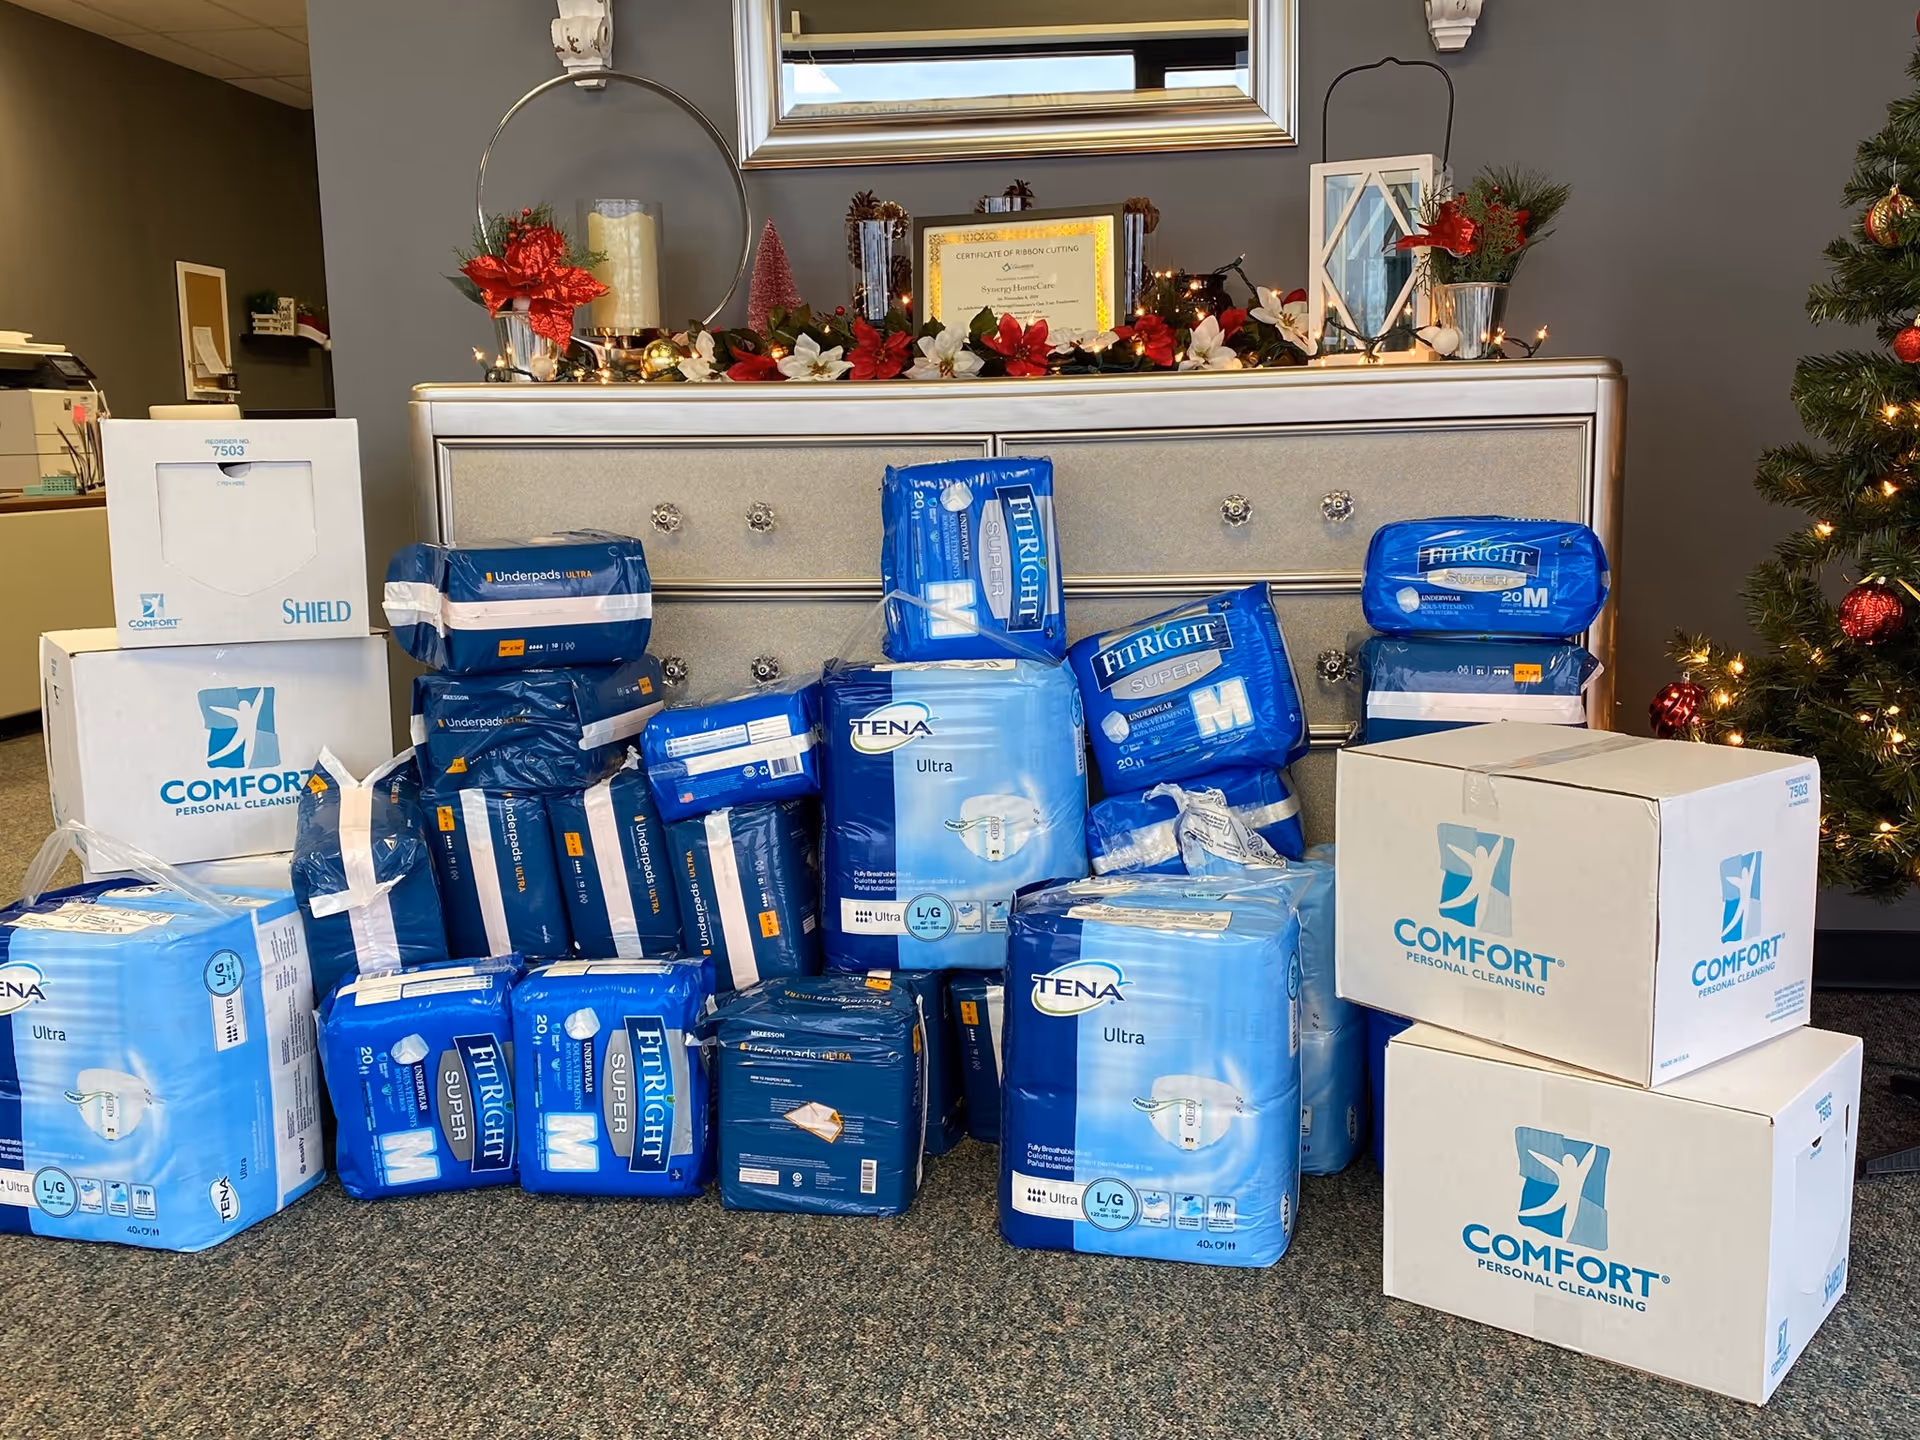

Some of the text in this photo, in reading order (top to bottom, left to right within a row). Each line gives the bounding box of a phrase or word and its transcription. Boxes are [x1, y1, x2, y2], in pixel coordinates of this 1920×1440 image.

[955, 245, 1079, 260] CERTIFICATE OF RIBBON CUTTING
[212, 445, 245, 456] 7503
[914, 491, 924, 509] 20
[959, 512, 970, 561] UNDERWEAR
[985, 520, 1005, 597] SUPER
[1008, 495, 1038, 621] FITRIGHT
[1428, 544, 1533, 567] FITRIGHT
[495, 570, 593, 583] Underpads ULTRA
[1445, 572, 1508, 586] SUPER
[927, 580, 978, 638] M
[1421, 594, 1461, 602] UNDERWEAR
[1501, 587, 1548, 608] 20 M
[128, 618, 180, 628] COMFORT
[283, 599, 351, 624] SHIELD
[1100, 621, 1215, 678] FITRIGHT
[1130, 660, 1202, 694] SUPER
[1128, 702, 1173, 721] UNDERWEAR
[1191, 678, 1253, 738] M
[851, 720, 933, 736] TENA
[916, 759, 954, 773] Ultra
[1116, 757, 1134, 770] 20
[160, 769, 313, 805] COMFORT
[1789, 783, 1808, 799] 7503
[175, 795, 302, 816] PERSONAL CLEANSIN
[502, 797, 526, 893] Underpads ULTRA
[634, 823, 660, 915] Underpads ULTRA
[685, 850, 709, 948] Underpads ULTRA
[874, 911, 901, 922] Ultra
[916, 906, 941, 920] L/G
[1393, 918, 1556, 983] COMFORT
[1691, 934, 1781, 987] COMFORT
[215, 962, 226, 987] L/G
[1406, 951, 1546, 997] PERSONAL CLEANSING
[1698, 961, 1776, 999] PERSONAL CLEANSING
[1033, 976, 1125, 1001] TENA
[225, 997, 235, 1024] Ultra
[33, 1025, 67, 1042] Ultra
[536, 1014, 548, 1034] 20
[1104, 1027, 1145, 1045] Ultra
[360, 1047, 373, 1065] 20
[584, 1042, 594, 1094] UNDERWEAR
[414, 1064, 428, 1112] UNDERWEAR
[572, 1042, 583, 1111] SOUS-VÊTEMENTS
[445, 1071, 467, 1141] SUPER
[468, 1044, 505, 1162] FITRIGHT
[611, 1053, 628, 1134] SUPER
[636, 1028, 665, 1162] FITRIGHT
[298, 1137, 306, 1163] essity
[547, 1114, 598, 1171] M
[1028, 1143, 1041, 1153] Fully
[240, 1157, 248, 1180] Ultra
[382, 1129, 440, 1184] M
[1027, 1151, 1053, 1161] Culotte
[1027, 1159, 1082, 1171] Pañal totalmen
[6, 1180, 30, 1193] Ultra
[43, 1180, 66, 1194] L/G
[1049, 1192, 1078, 1206] Ultra
[219, 1176, 230, 1224] TENA
[1096, 1192, 1124, 1207] L/G
[127, 1225, 141, 1235] 40x
[1196, 1240, 1214, 1249] 40x
[1462, 1224, 1660, 1298] COMFORT
[1477, 1258, 1647, 1312] PERSONAL CLEANSING
